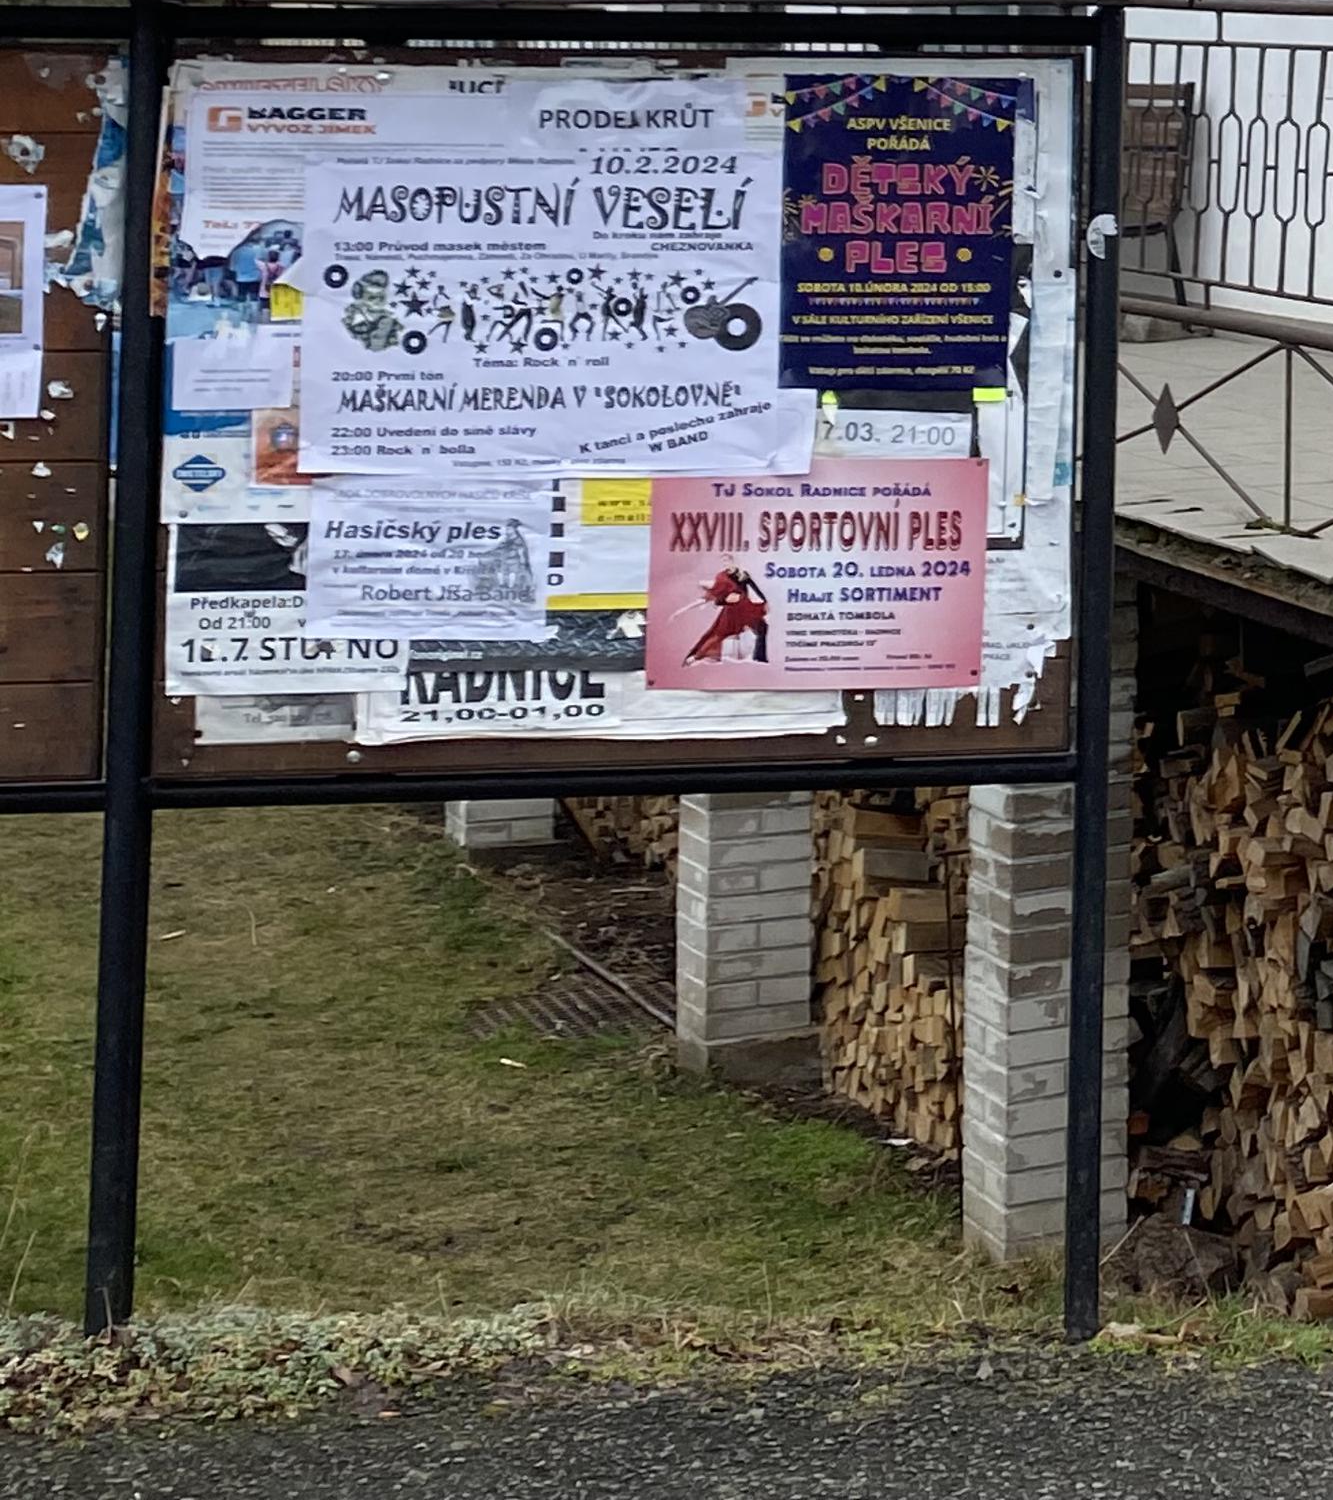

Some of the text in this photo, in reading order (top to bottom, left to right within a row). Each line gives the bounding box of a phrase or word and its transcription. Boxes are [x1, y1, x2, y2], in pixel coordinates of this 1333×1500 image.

[646, 102, 714, 128] KRŮT
[589, 155, 738, 175] 10.2.2024
[822, 155, 976, 196] DĚTSKÝ
[332, 177, 581, 228] MASOPUSTNÍ
[592, 177, 754, 231] VESELÍ
[801, 193, 995, 236] MAŠKARNÍ
[334, 242, 374, 251] 13:00
[845, 240, 948, 274] PLES
[523, 357, 559, 367] Rock
[331, 371, 373, 381] 20:00
[336, 383, 458, 413] MAŠKARNÍ
[459, 385, 566, 413] MERENDA
[573, 386, 587, 407] V
[331, 427, 372, 438] 22:00
[440, 426, 459, 437] do
[579, 442, 592, 453] K
[594, 435, 632, 451] tanci
[718, 401, 772, 422] zahraje
[890, 424, 956, 446] 21:00
[667, 431, 709, 449] BAND
[331, 445, 372, 455] 23:00
[376, 445, 413, 455] Rock
[712, 482, 737, 498] TJ
[324, 518, 501, 544] Hasičský ples
[669, 499, 963, 552] XXVIII. SPORTOVNÍ PLES
[833, 562, 864, 578] 20.
[922, 561, 970, 578] 2024
[361, 585, 432, 601] Robert
[840, 586, 943, 602] SORTIMENT
[199, 618, 223, 630] Od
[227, 616, 272, 630] 21:00
